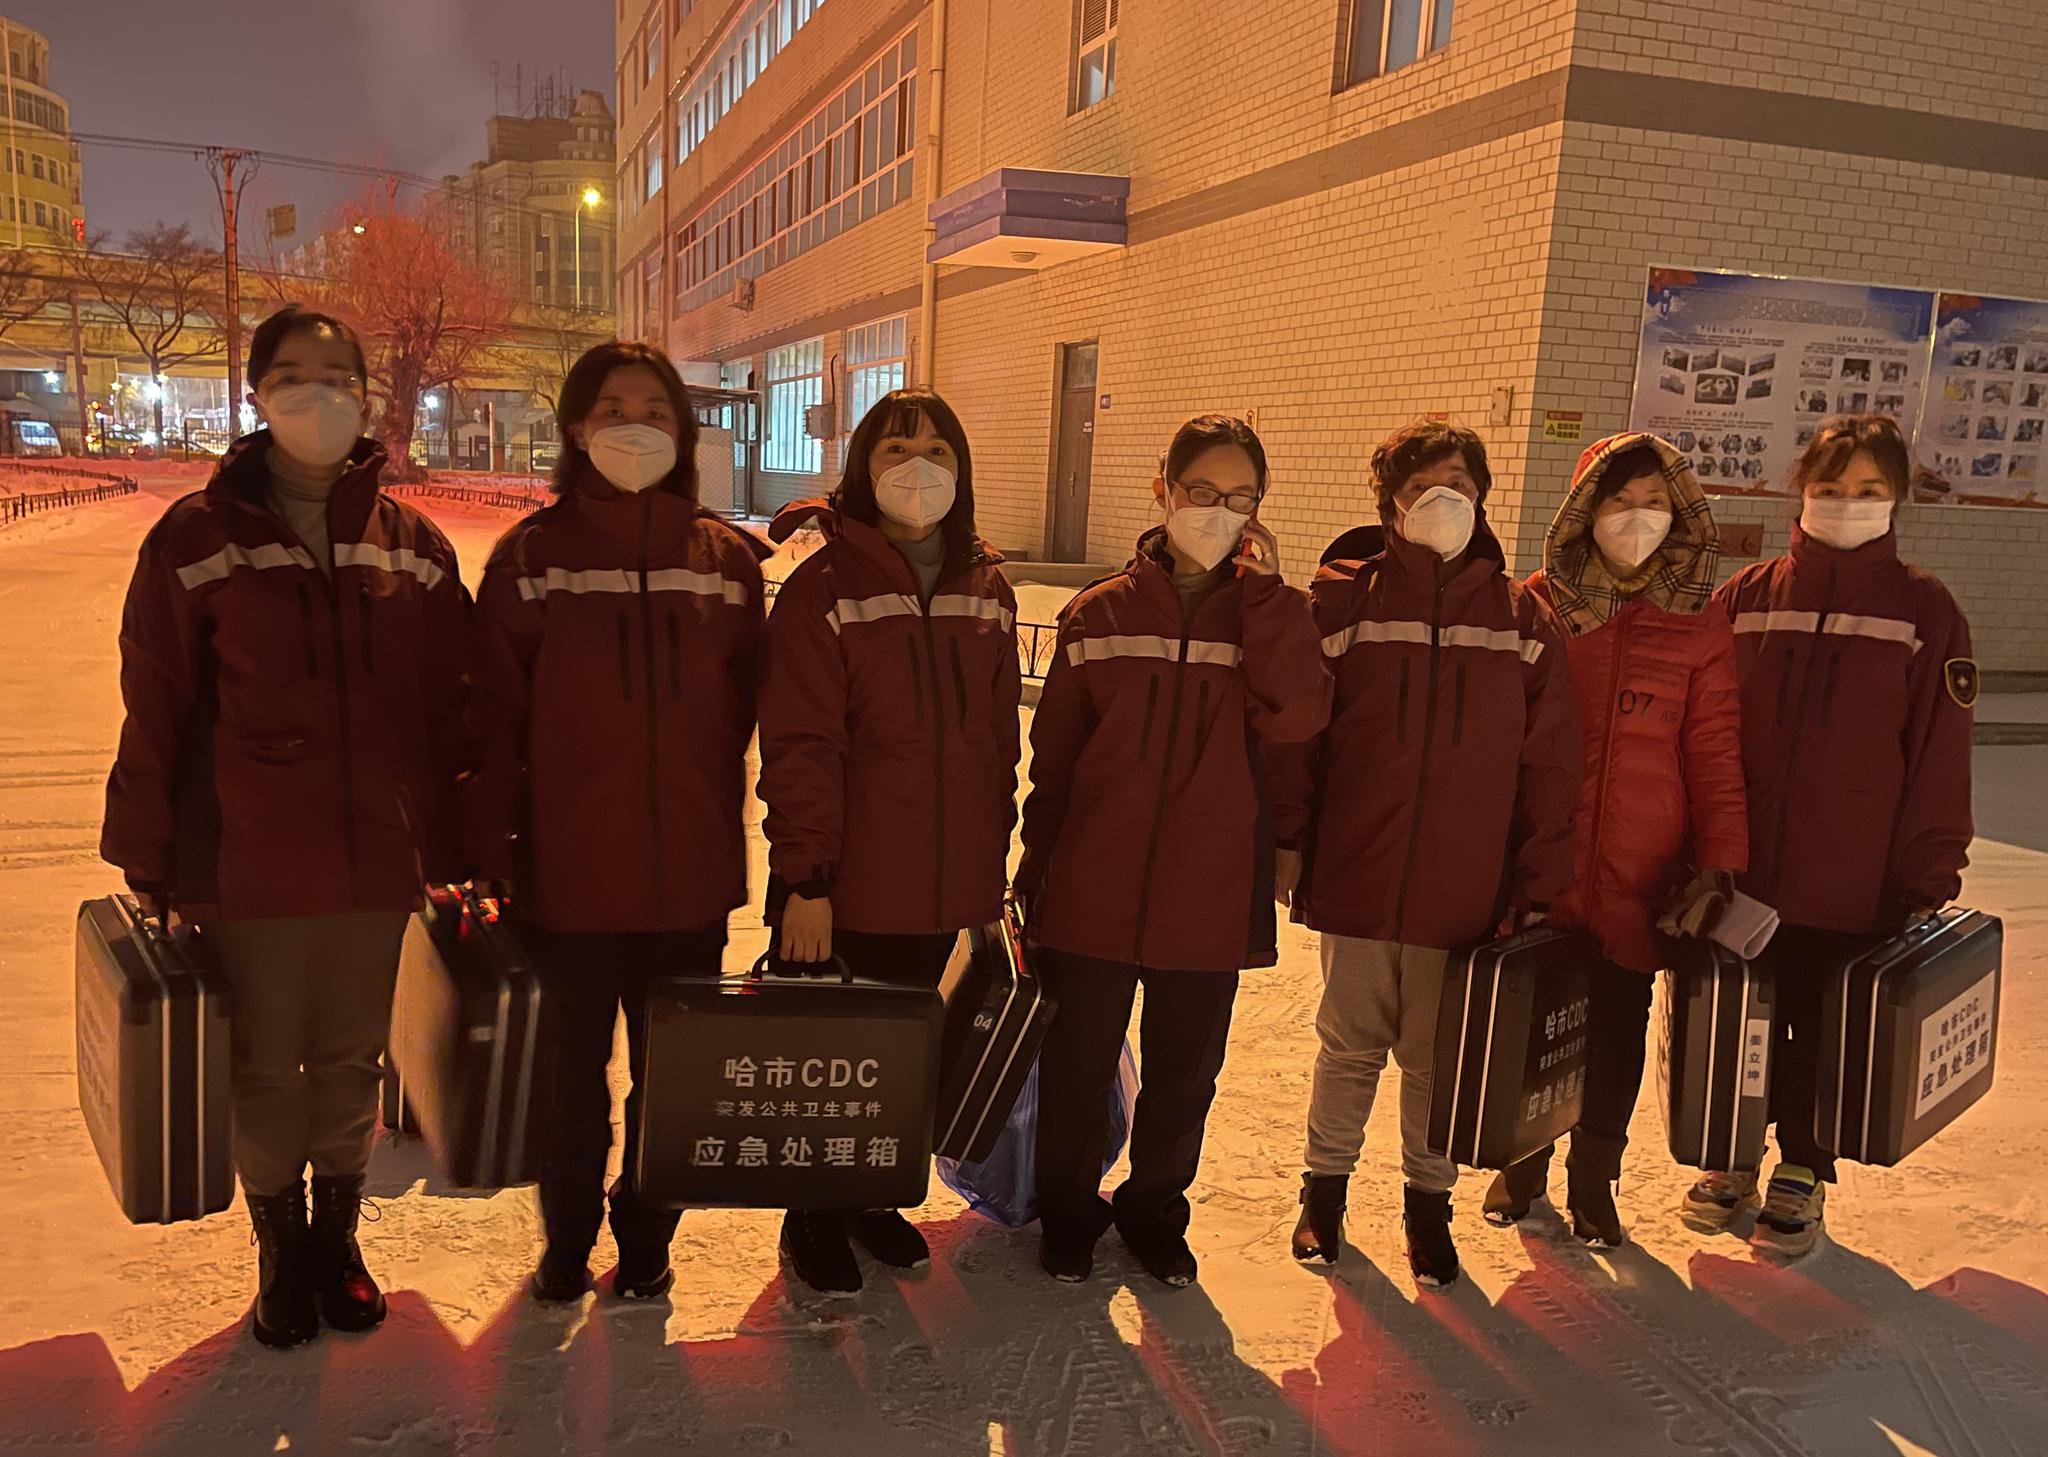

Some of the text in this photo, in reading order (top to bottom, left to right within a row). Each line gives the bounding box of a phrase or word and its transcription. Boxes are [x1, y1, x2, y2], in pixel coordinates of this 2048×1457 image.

[1618, 689, 1655, 718] 07
[973, 1014, 993, 1031] 04
[1545, 997, 1589, 1041] 哈市CDC
[1940, 997, 1980, 1037] 哈市CDC
[723, 1056, 880, 1089] 哈市CDC
[1920, 1030, 1989, 1101] 应急处理箱
[714, 1100, 883, 1118] 突发公共卫生事件
[691, 1136, 899, 1168] 应急处理箱
